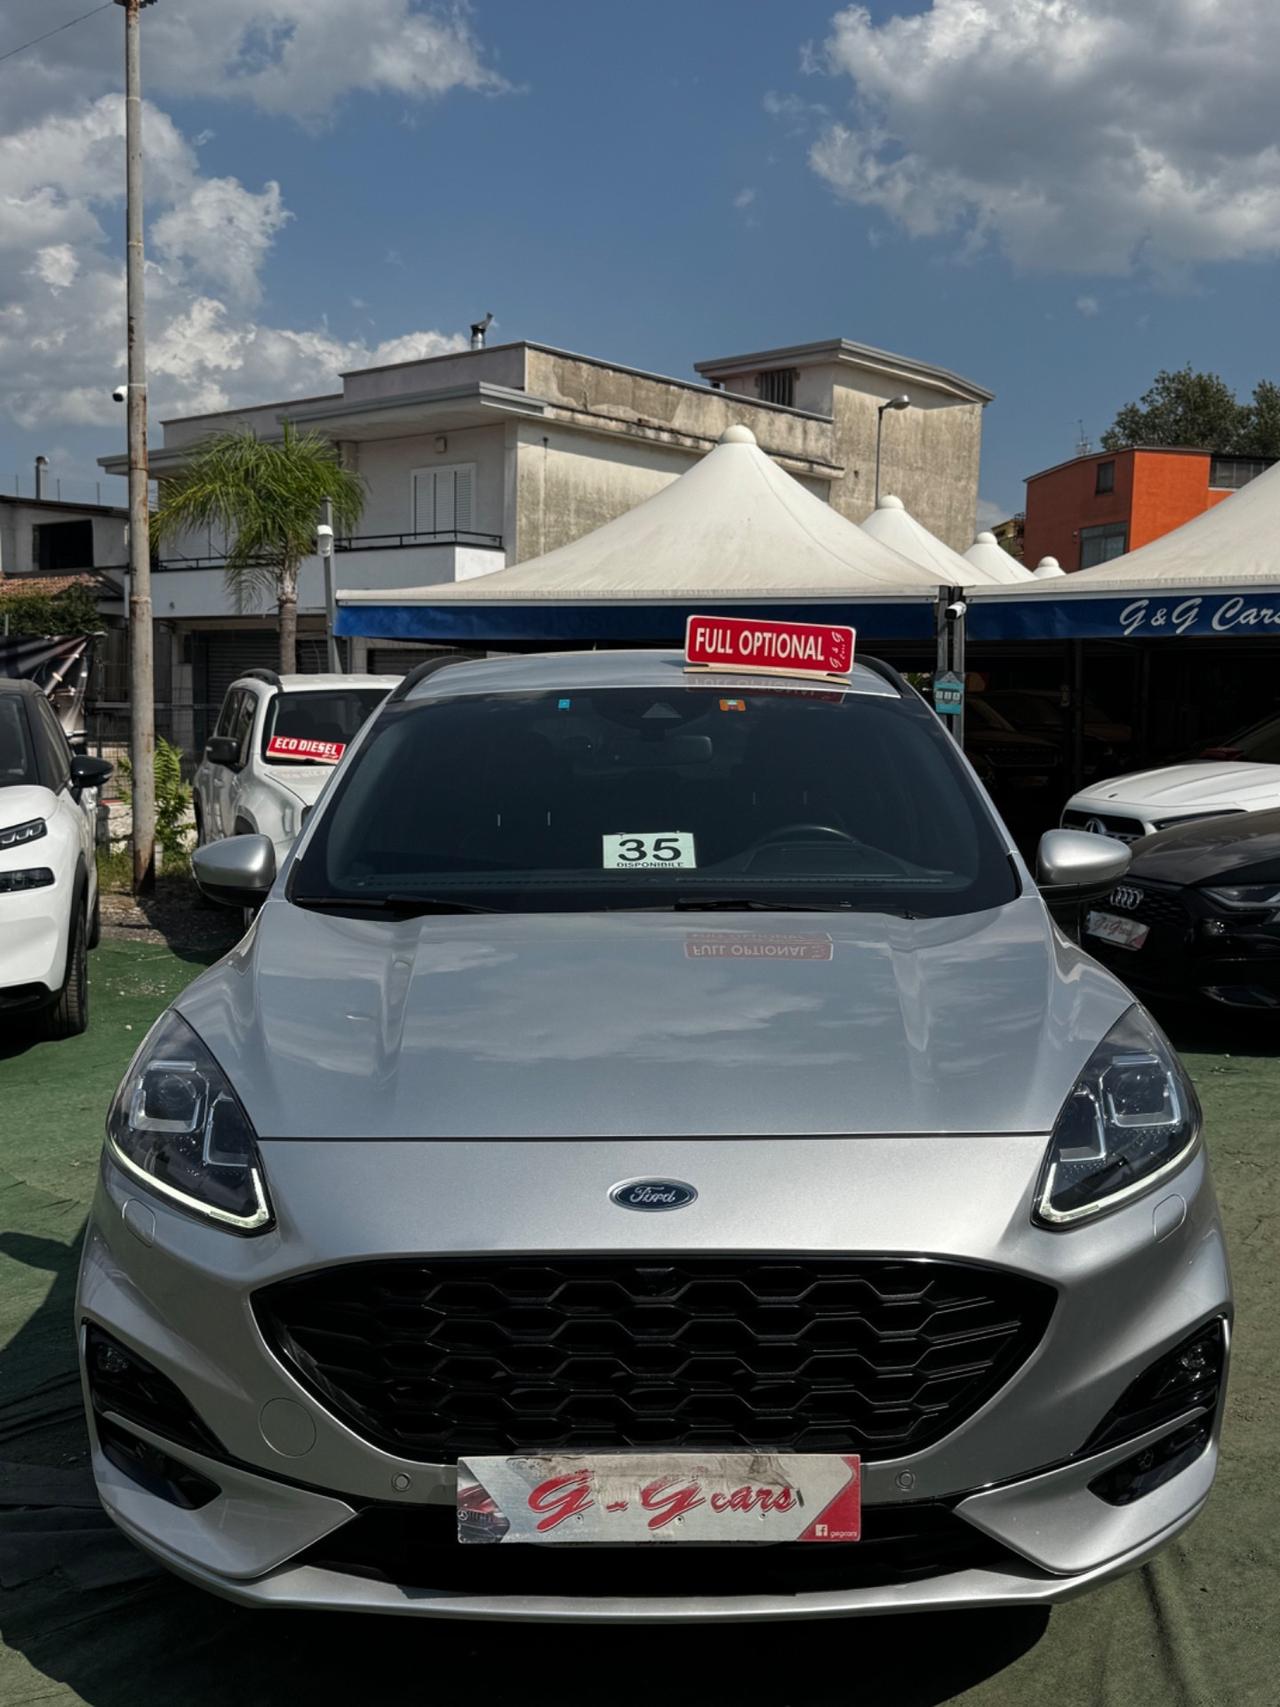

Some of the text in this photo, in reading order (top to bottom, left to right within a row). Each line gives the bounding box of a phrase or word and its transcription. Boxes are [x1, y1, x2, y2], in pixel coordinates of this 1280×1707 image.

[695, 627, 824, 661] FULL OPTIONAL
[274, 737, 338, 755] ECO DIESEL
[618, 838, 682, 861] 35
[630, 1186, 676, 1203] Ford
